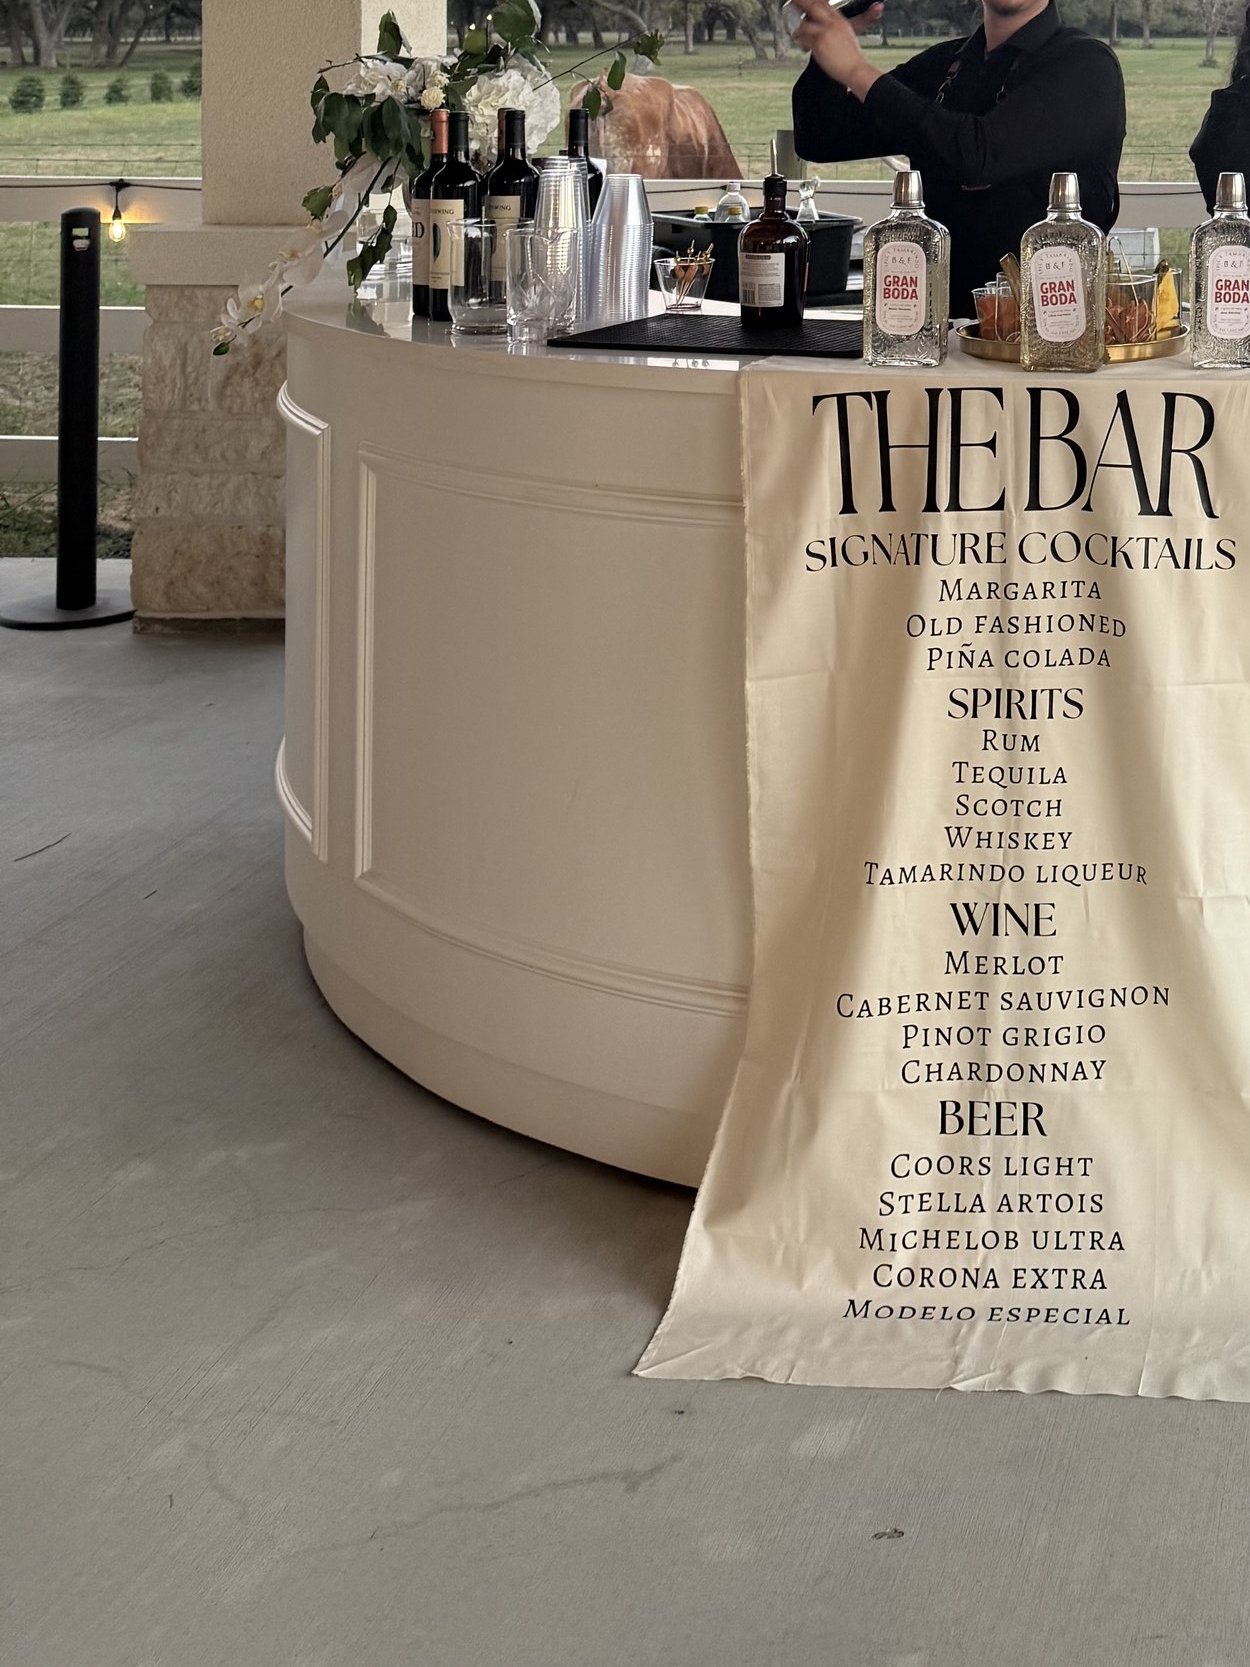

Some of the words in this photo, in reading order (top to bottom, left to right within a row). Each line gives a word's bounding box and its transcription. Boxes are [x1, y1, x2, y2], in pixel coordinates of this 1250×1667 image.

[883, 275, 918, 287] GRAN
[883, 288, 918, 300] BODA
[1040, 280, 1075, 294] GRAN
[1215, 279, 1250, 291] GRAN
[1041, 292, 1077, 307] BODA
[1214, 291, 1250, 303] BODA
[811, 386, 1006, 515] THE
[1023, 386, 1220, 519] BAR
[805, 531, 1007, 572] SIGNATURE
[1018, 530, 1236, 570] COCKTAILS
[938, 578, 1102, 602] MARGARITA
[906, 614, 963, 638] OLD
[974, 613, 1126, 638] FASHIONED
[926, 642, 995, 671] PIÑA
[1004, 647, 1111, 669] COLADA
[947, 687, 1084, 721] SPIRITS
[981, 729, 1040, 752] RUM
[951, 761, 1068, 789] TEQUILA
[955, 793, 1062, 818] SCOTCH
[944, 825, 1073, 851] WHISKEY
[863, 861, 1025, 886] TAMARINDO
[1036, 862, 1148, 887] LIQUEUR
[949, 902, 1057, 937] WINE
[944, 950, 1064, 976] MERLOT
[836, 990, 990, 1019] CABERNET
[1000, 985, 1170, 1011] SAUVIGNON
[902, 1024, 992, 1049] PINOT
[1002, 1024, 1106, 1047] GRIGIO
[901, 1059, 1107, 1084] CHARDONNAY
[939, 1100, 1048, 1137] BEER
[890, 1153, 991, 1179] COORS
[1004, 1156, 1093, 1177] LIGHT
[879, 1191, 987, 1217] STELLA
[996, 1193, 1103, 1214] ARTOIS
[859, 1227, 1019, 1252] MICHELOB
[1031, 1230, 1125, 1251] ULTRA
[873, 1263, 1000, 1289] CORONA
[1012, 1268, 1108, 1290] EXTRA
[842, 1298, 976, 1321] MODELO
[987, 1306, 1130, 1326] ESPECIAL
